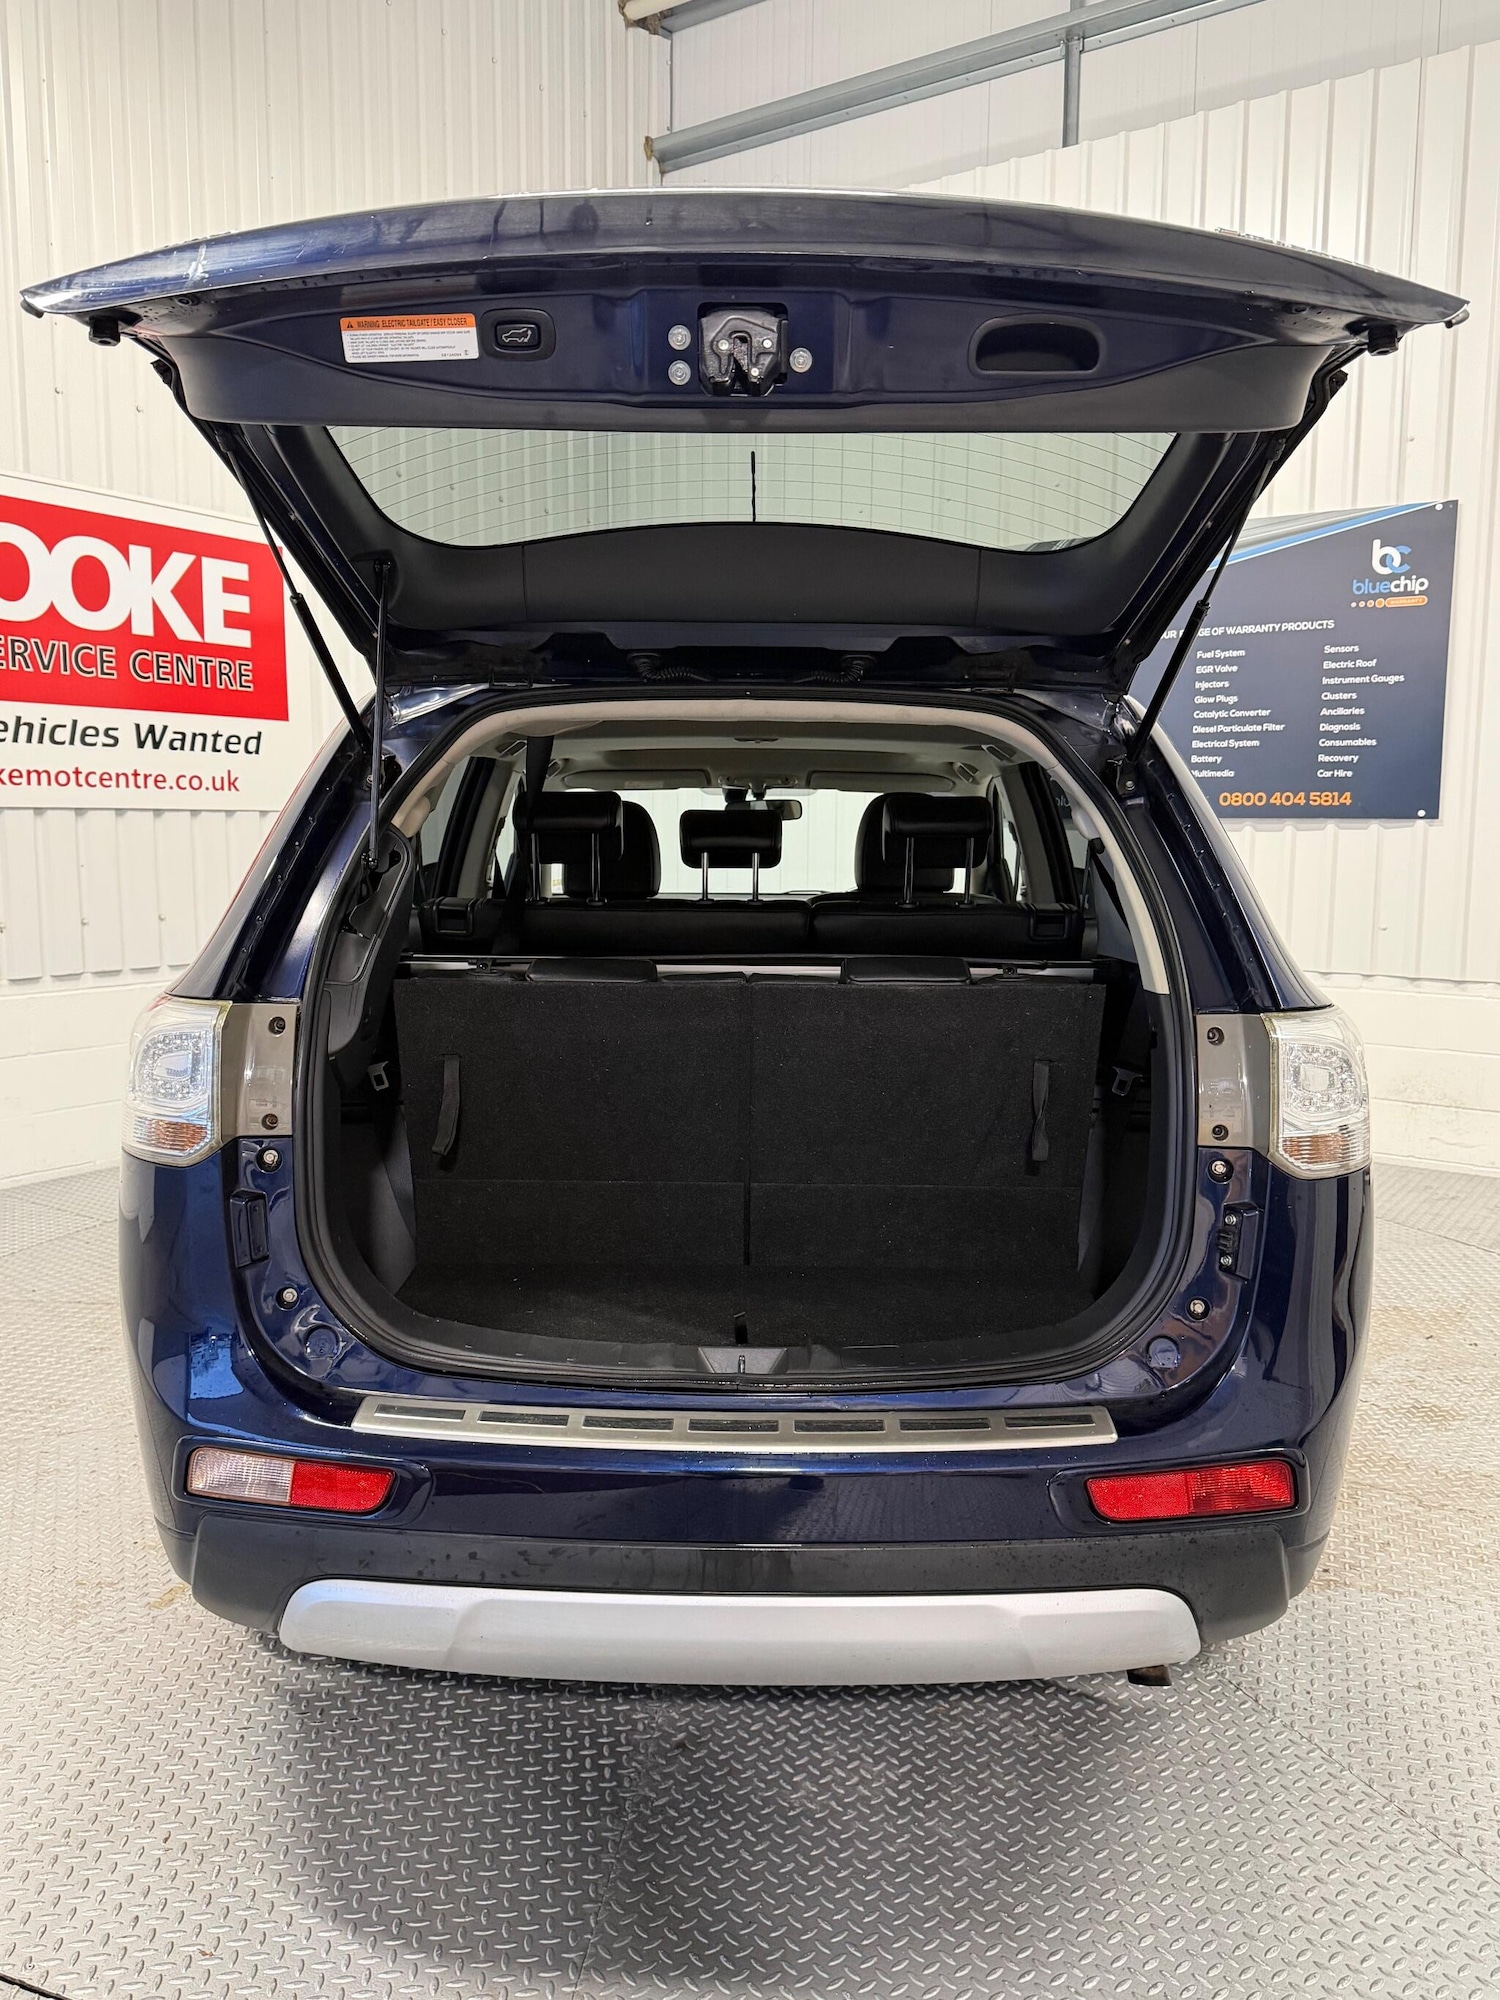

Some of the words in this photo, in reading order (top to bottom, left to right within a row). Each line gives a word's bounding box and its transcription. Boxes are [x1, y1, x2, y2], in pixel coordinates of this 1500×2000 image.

[357, 320, 380, 328] WARNING
[381, 319, 406, 328] ELECTRIC
[406, 318, 430, 327] TAILGATE
[433, 318, 446, 326] EASY
[446, 317, 468, 326] CLOSER
[1352, 575, 1429, 595] bluechip
[1211, 626, 1225, 636] OF
[1225, 623, 1281, 635] WARRANTY
[1281, 619, 1336, 632] PRODUCTS
[1196, 650, 1215, 659] Fuel
[1215, 648, 1246, 659] System
[1323, 644, 1360, 654] Sensors
[1196, 665, 1214, 674] EGR
[1214, 664, 1238, 673] Valve
[1322, 659, 1355, 669] Electric
[1355, 658, 1378, 668] Roof
[129, 649, 253, 691] CENTRE
[1322, 675, 1370, 685] Instrument
[1370, 674, 1405, 685] Gauges
[1195, 680, 1230, 691] Injectors
[1194, 695, 1215, 704] Glow
[1215, 694, 1239, 705] Plugs
[1321, 691, 1358, 700] Clusters
[1193, 709, 1229, 719] Catalytic
[1229, 708, 1272, 718] Converter
[1320, 706, 1365, 716] Ancillaries
[1192, 724, 1217, 734] Diesel
[1217, 723, 1262, 733] Particulate
[1262, 723, 1286, 732] Filter
[1319, 722, 1361, 734] Diagnosis
[134, 723, 262, 755] Wanted
[1191, 740, 1228, 748] Electrical
[1228, 738, 1260, 748] System
[1318, 737, 1378, 747] Consumables
[1190, 754, 1222, 764] Battery
[1317, 753, 1359, 763] Recovery
[1190, 768, 1235, 778] Multimedia
[1317, 769, 1334, 778] Car
[1333, 769, 1353, 778] Hire
[1218, 791, 1267, 806] 0800
[1269, 791, 1306, 806] 404
[1308, 791, 1352, 806] 5814
